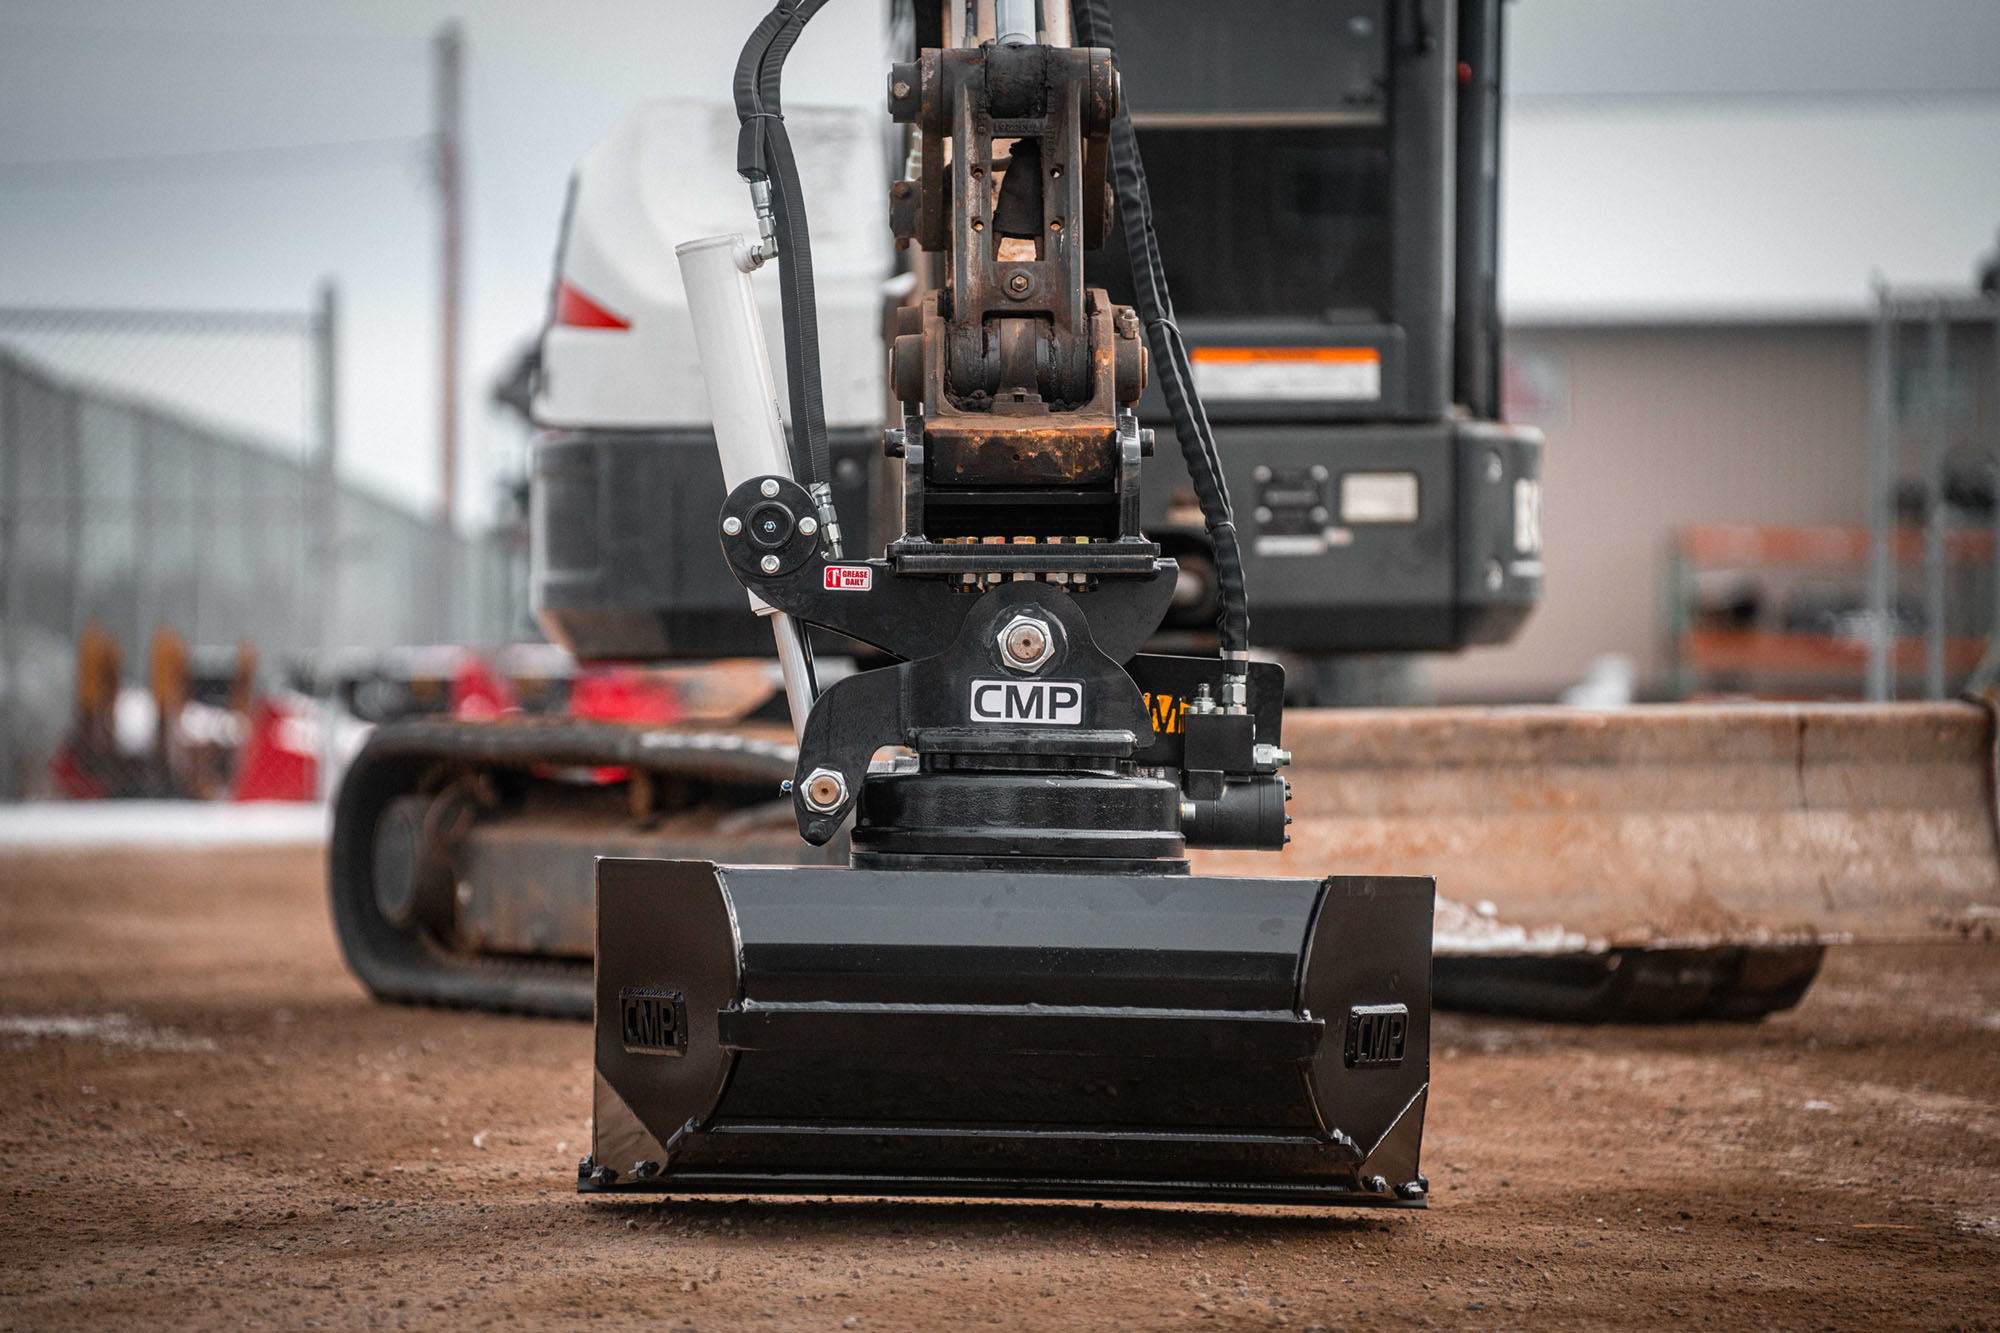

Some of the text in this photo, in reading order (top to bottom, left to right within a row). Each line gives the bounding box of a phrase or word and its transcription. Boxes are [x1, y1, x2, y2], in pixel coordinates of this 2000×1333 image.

[842, 570, 868, 578] GREASE
[845, 578, 865, 586] DAILY
[974, 684, 1079, 720] CMP
[624, 998, 674, 1048] CMP
[1357, 1014, 1405, 1062] CMP
